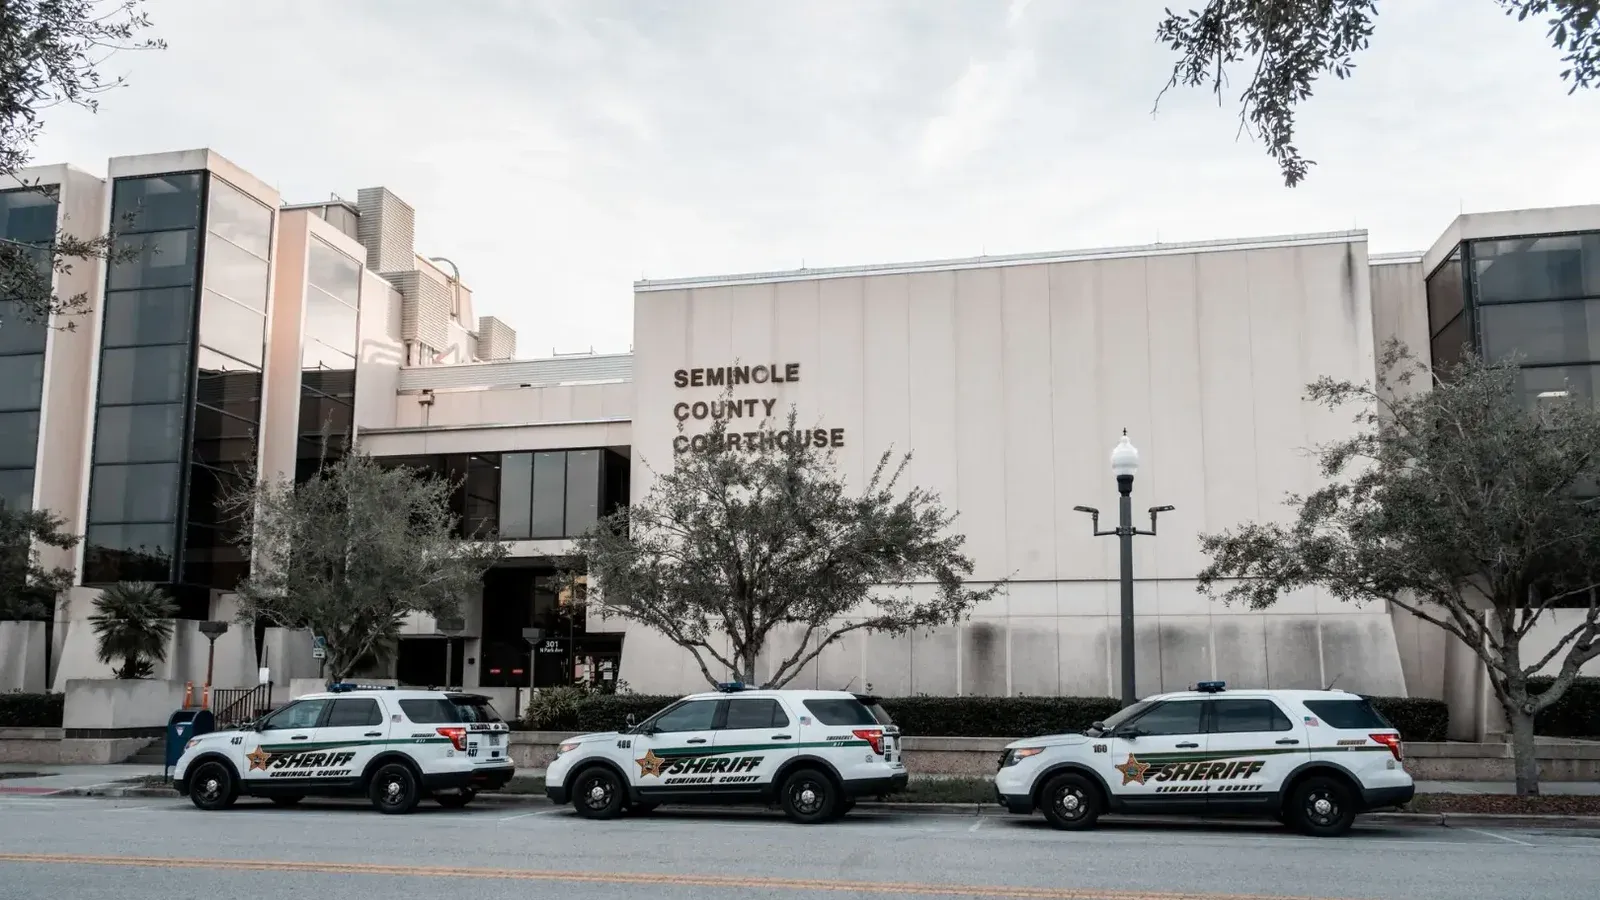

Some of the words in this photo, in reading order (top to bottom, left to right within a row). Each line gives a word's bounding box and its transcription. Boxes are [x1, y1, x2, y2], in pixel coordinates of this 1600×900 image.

[674, 363, 800, 388] SEMINOLE
[674, 398, 777, 421] COUNTY
[273, 751, 356, 769] SHERIFF
[668, 756, 765, 775] SHERIFF
[270, 770, 312, 778] SEMINOLE
[316, 769, 352, 777] COUNTY
[664, 776, 714, 784] SEMINOLE
[719, 775, 761, 783] COUNTY
[1155, 760, 1266, 782] SHERIFF
[1155, 785, 1210, 793] SEMINOLE
[1217, 784, 1263, 792] COUNTY
